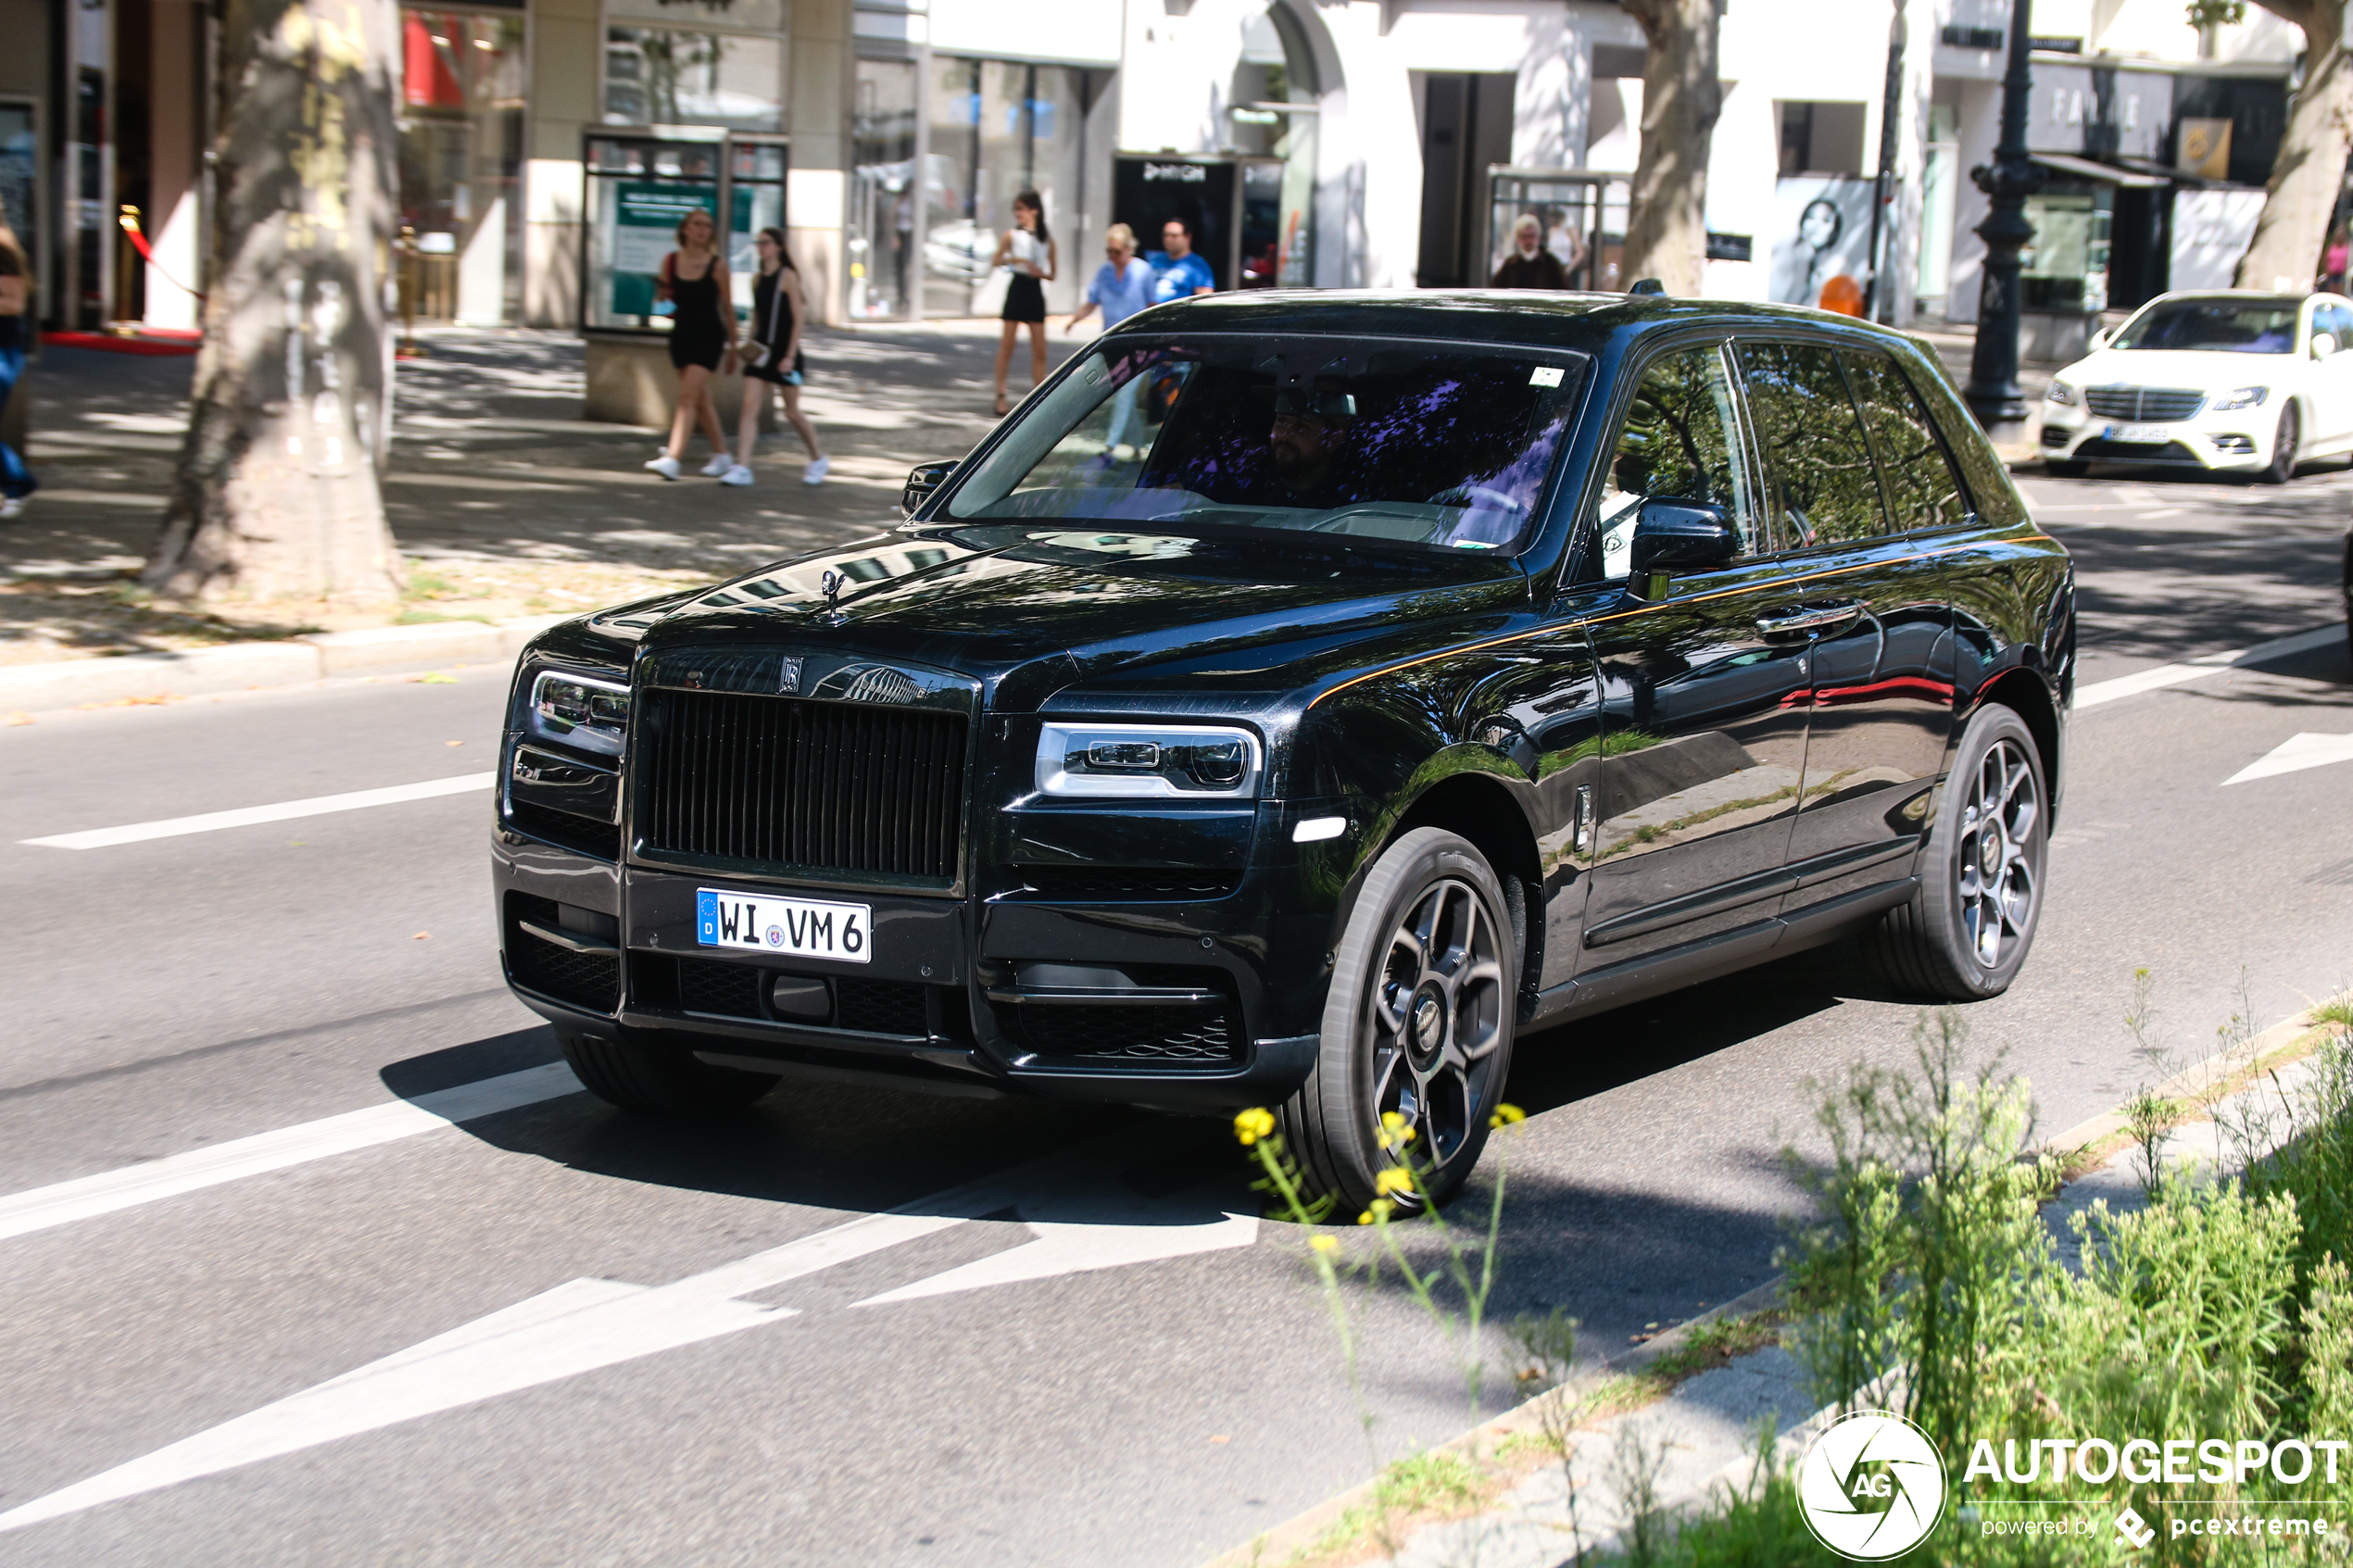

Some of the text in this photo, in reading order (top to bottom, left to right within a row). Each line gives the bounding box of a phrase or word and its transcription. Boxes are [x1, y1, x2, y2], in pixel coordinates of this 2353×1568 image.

[2050, 88, 2140, 131] FALE
[704, 922, 713, 935] D
[719, 900, 862, 953] WI VM 6
